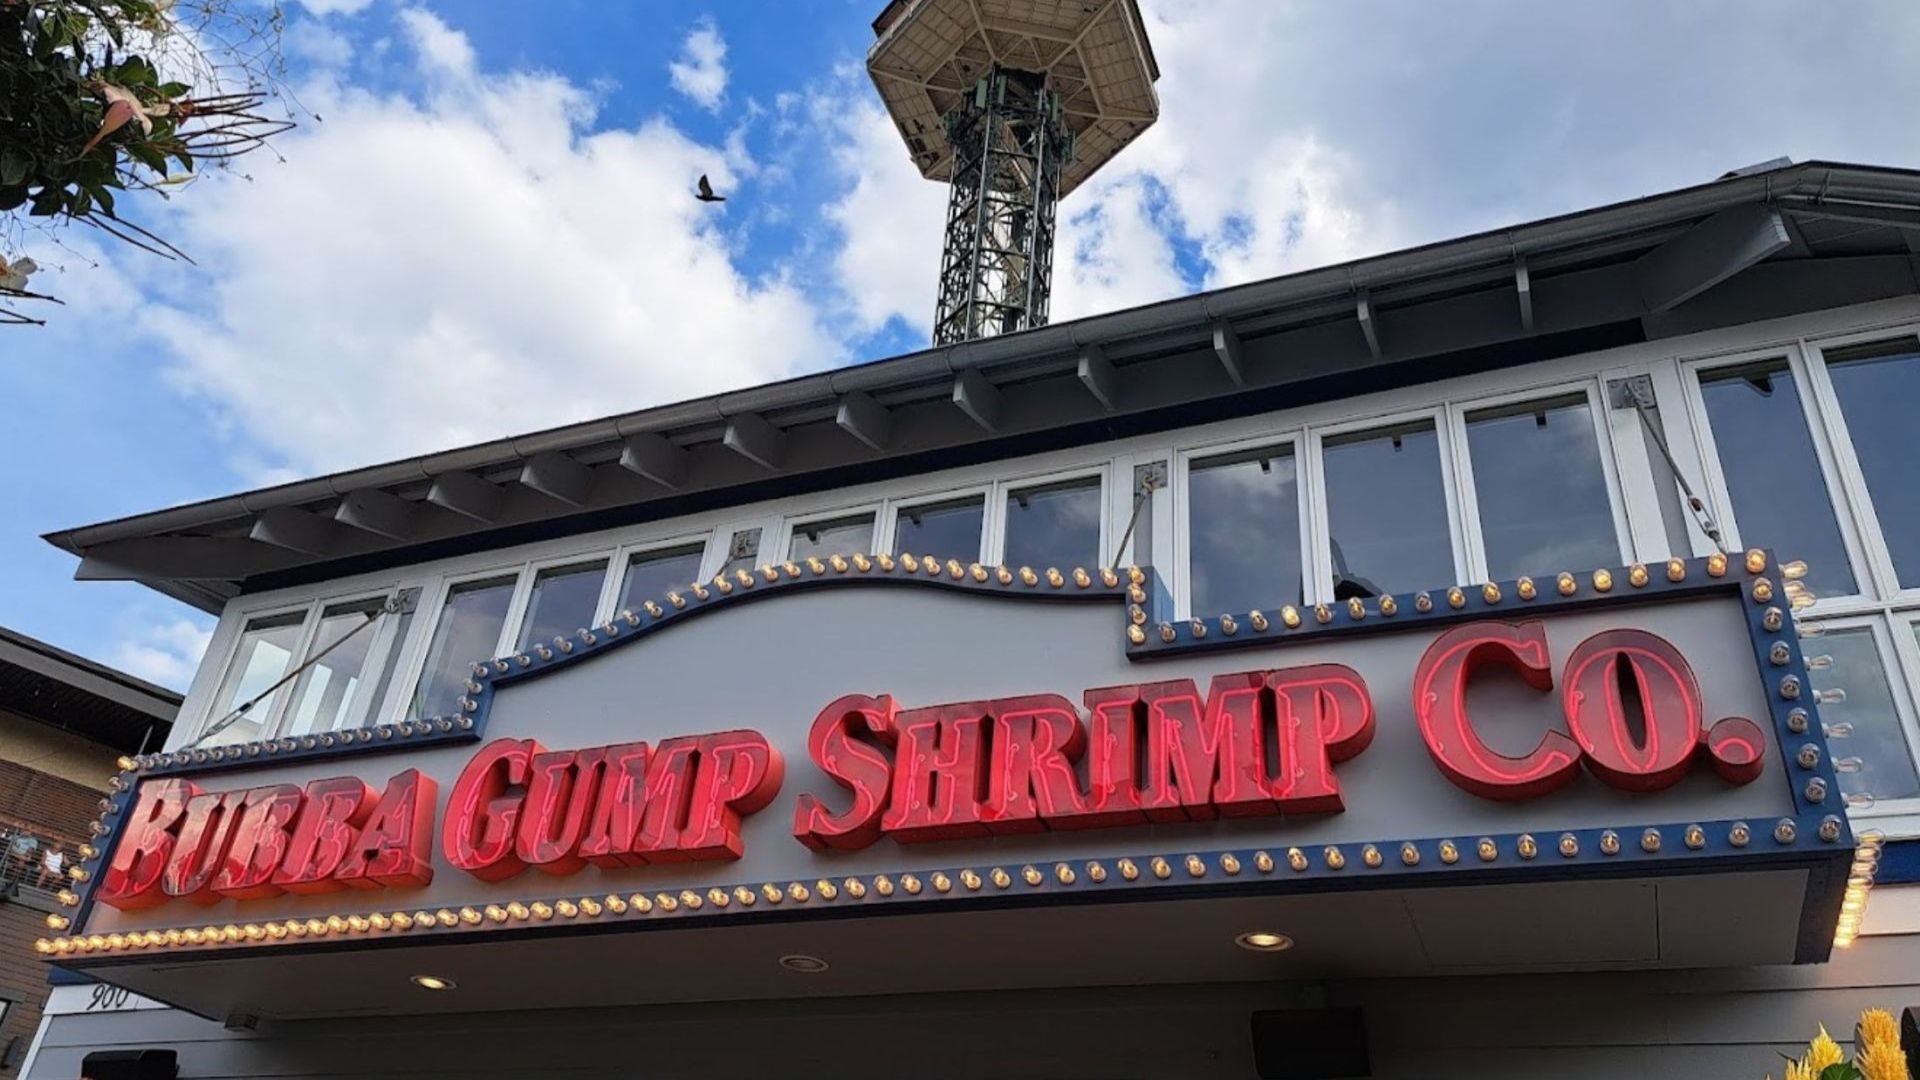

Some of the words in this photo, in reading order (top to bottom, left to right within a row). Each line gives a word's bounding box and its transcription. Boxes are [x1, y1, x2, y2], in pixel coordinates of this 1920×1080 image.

[96, 767, 438, 911] BUBBA
[441, 729, 785, 881] GUMP
[793, 663, 1376, 852] SHRIMP
[1413, 619, 1766, 801] CO.
[86, 984, 130, 1010] 900
